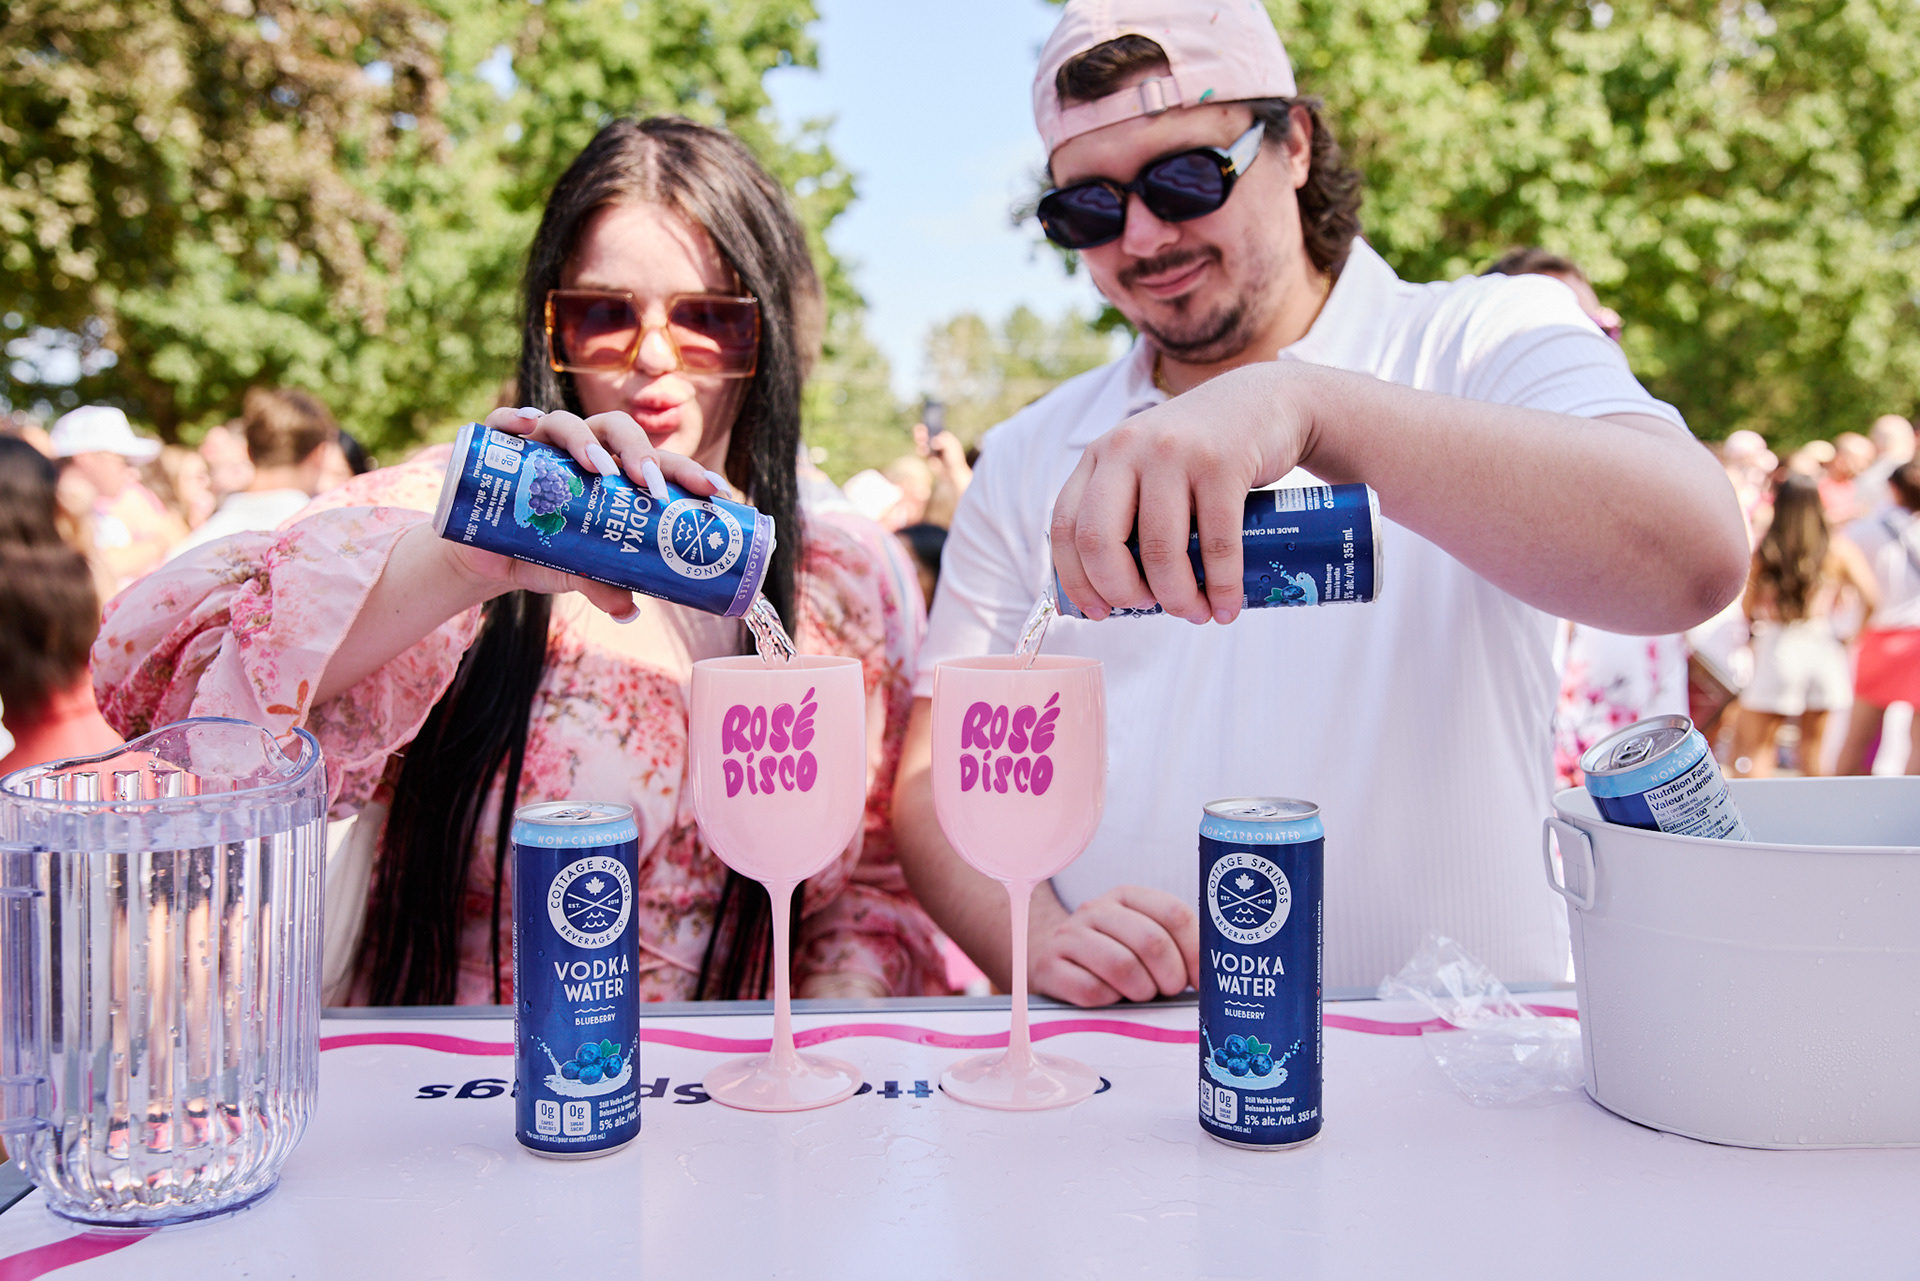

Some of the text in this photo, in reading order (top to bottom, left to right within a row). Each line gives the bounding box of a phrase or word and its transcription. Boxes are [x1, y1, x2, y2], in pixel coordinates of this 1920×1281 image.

[480, 473, 494, 489] 5%
[580, 476, 602, 534] CONCORD GRAPE
[602, 486, 634, 542] WATER
[620, 487, 655, 554] VODKA
[1277, 526, 1300, 534] MADE
[686, 502, 740, 577] COTTAGE SPRINGS
[1242, 528, 1266, 536] CANA
[1342, 528, 1354, 540] mL
[1343, 542, 1354, 558] 355
[514, 553, 536, 562] MADE
[546, 562, 576, 574] CANADA
[721, 686, 819, 755] ROSÉ
[961, 692, 1061, 755] ROSÉ
[1648, 762, 1710, 802] Nutrition Facts
[1650, 766, 1677, 784] NON
[1652, 793, 1684, 811] Valeur
[1686, 770, 1714, 797] nutritive
[1662, 808, 1708, 833] Calories 100
[538, 828, 636, 846] NON-CARBONATED
[1203, 826, 1301, 842] NON-CARBONATED
[551, 860, 630, 909] COTTAGE SPRINGS
[1208, 856, 1288, 904] COTTAGE SPRINGS
[560, 918, 627, 946] BEVERAGE CO.
[1215, 915, 1281, 941] BEVERAGE CO.
[554, 954, 630, 981] VODKA
[1210, 948, 1285, 976] VODKA
[564, 978, 624, 1002] WATER
[1216, 972, 1276, 997] WATER
[575, 1012, 616, 1026] BLUEBERRY
[1224, 1007, 1266, 1020] BLUEBERRY
[599, 1100, 609, 1109] Still
[610, 1098, 622, 1106] Vodka
[1220, 1091, 1232, 1108] 0g
[1244, 1096, 1295, 1104] Still Vodka Beverage
[1244, 1104, 1265, 1112] Boisson
[541, 1103, 555, 1120] 0g
[570, 1104, 585, 1120] 0g
[599, 1108, 617, 1117] Boisson
[599, 1118, 613, 1131] 5%
[614, 1108, 637, 1128] alc./vol.
[1244, 1107, 1318, 1126] 5% alc./vol. 355 mL
